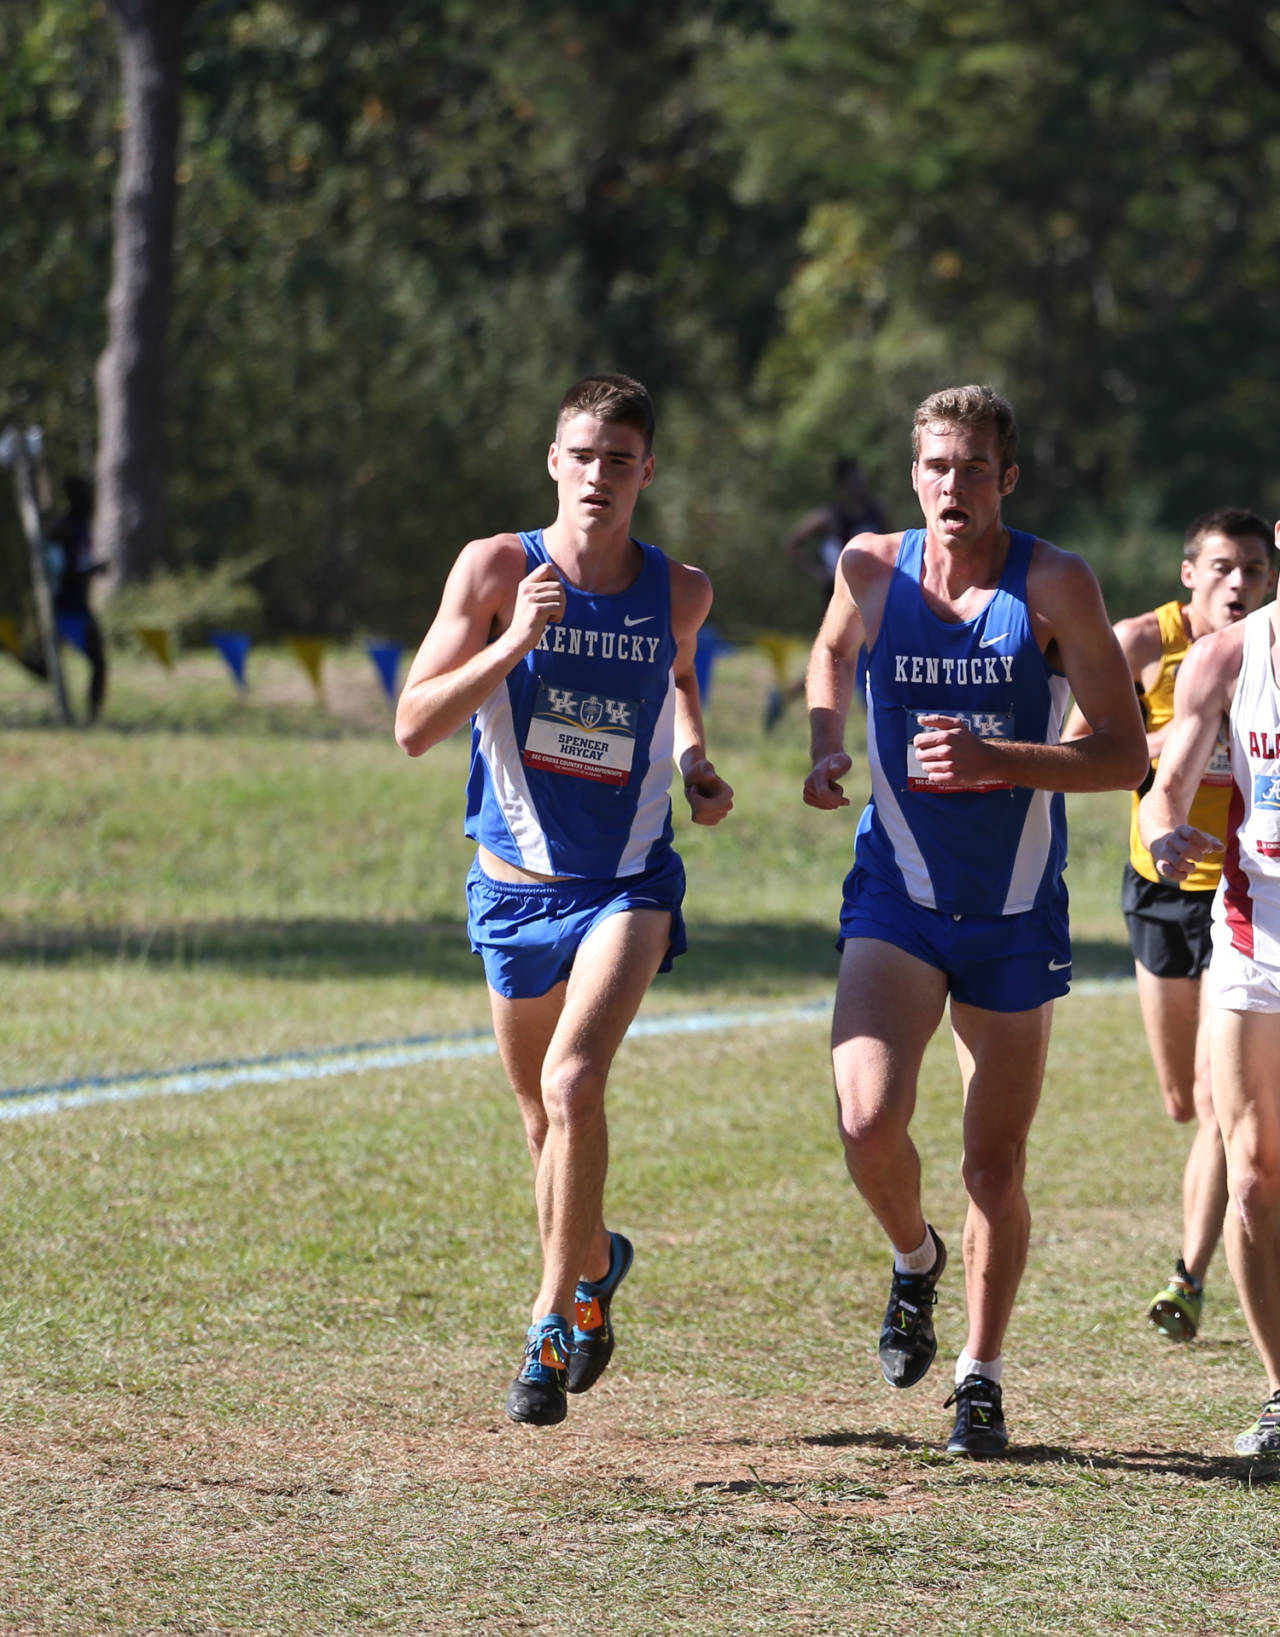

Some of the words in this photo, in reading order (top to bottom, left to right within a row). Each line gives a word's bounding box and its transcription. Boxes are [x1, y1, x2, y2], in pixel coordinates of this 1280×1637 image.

[535, 624, 660, 663] KENTUCKY
[894, 655, 1014, 685] KENTUCKY
[558, 733, 609, 753] SPENCER
[559, 744, 604, 761] HRYCAY
[559, 759, 583, 770] COUNTRY
